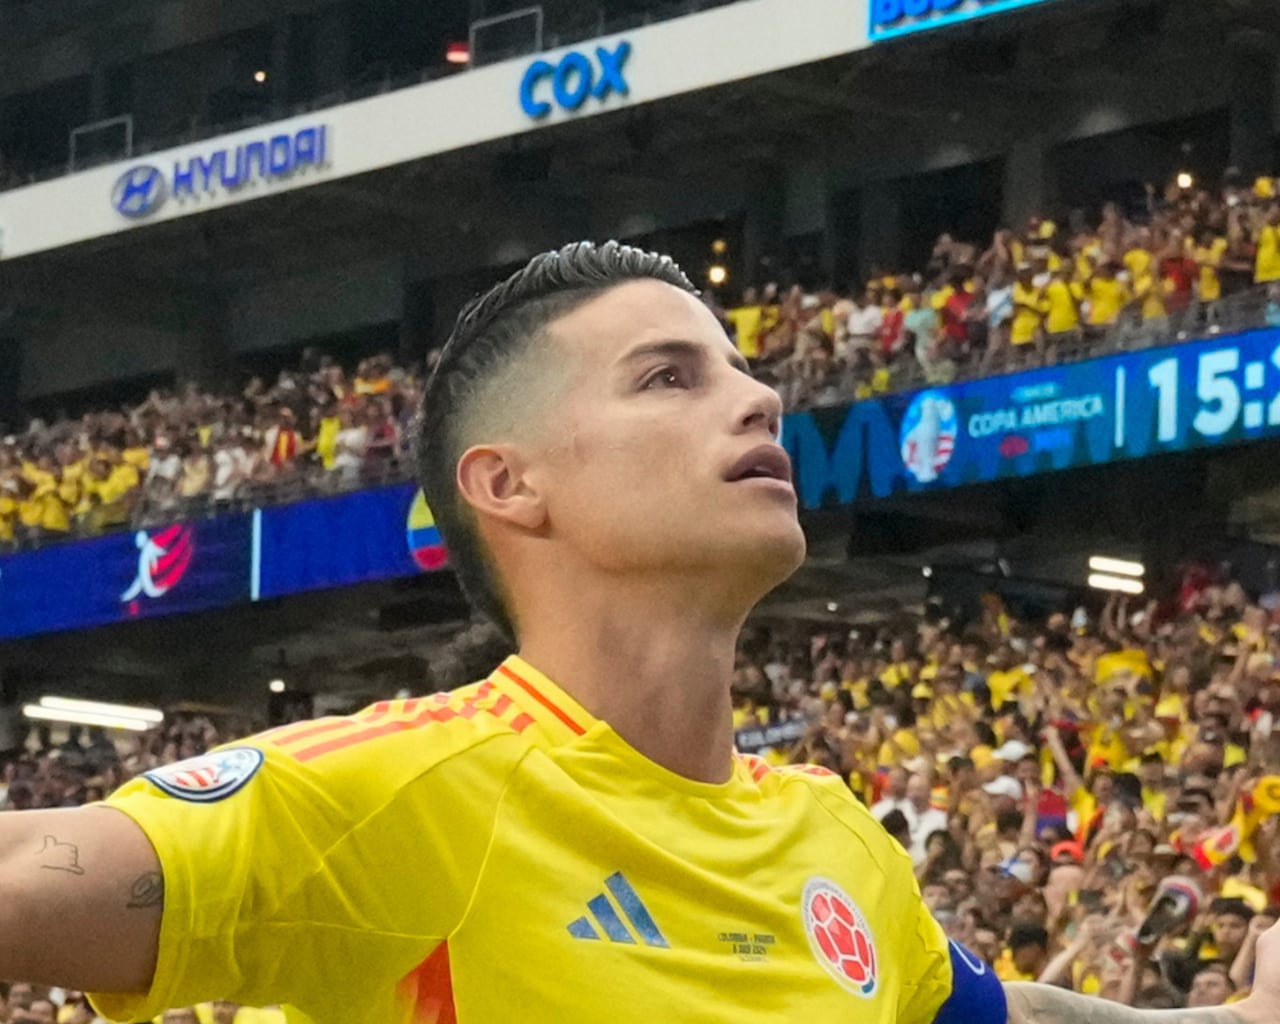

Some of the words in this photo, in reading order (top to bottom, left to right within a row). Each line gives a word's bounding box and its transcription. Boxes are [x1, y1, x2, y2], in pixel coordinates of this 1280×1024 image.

[520, 40, 630, 118] COX
[174, 124, 327, 197] HYUNDAI
[968, 408, 1018, 438] COPA
